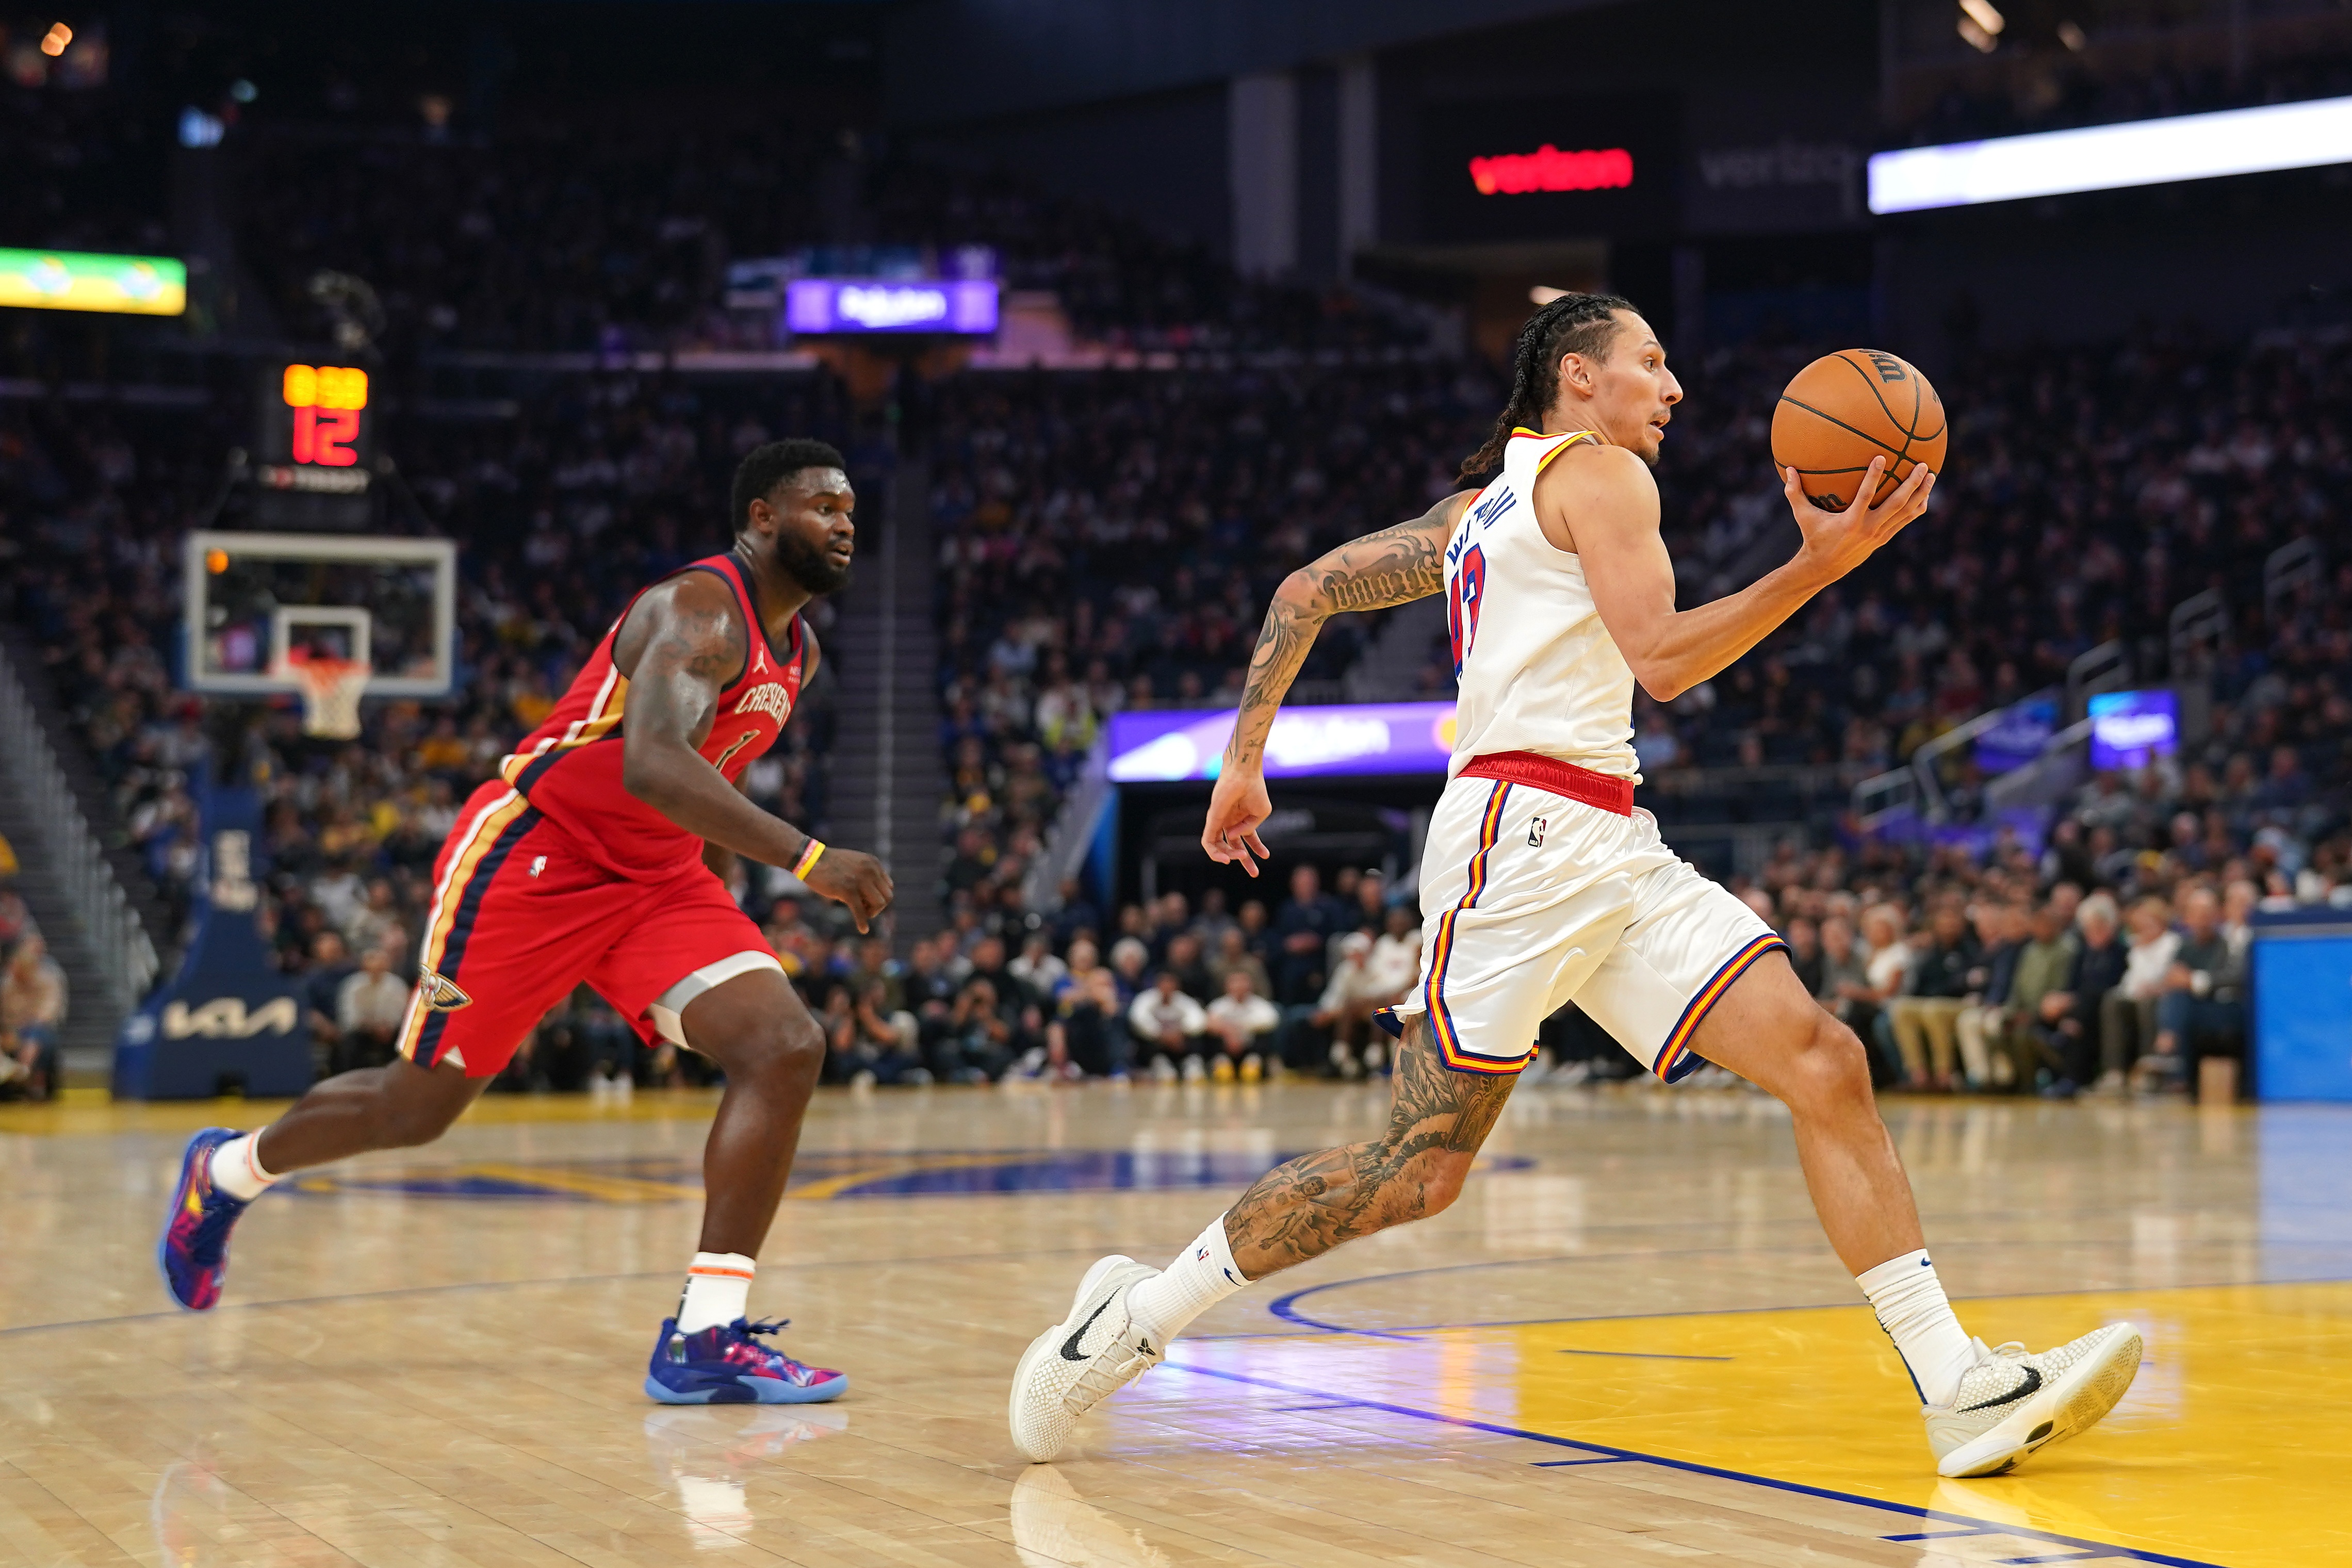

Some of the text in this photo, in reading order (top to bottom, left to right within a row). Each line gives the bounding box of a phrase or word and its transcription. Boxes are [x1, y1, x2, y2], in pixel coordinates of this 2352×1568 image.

[292, 406, 360, 466] 12
[734, 681, 791, 734] CRESCEN
[714, 728, 761, 773] 1
